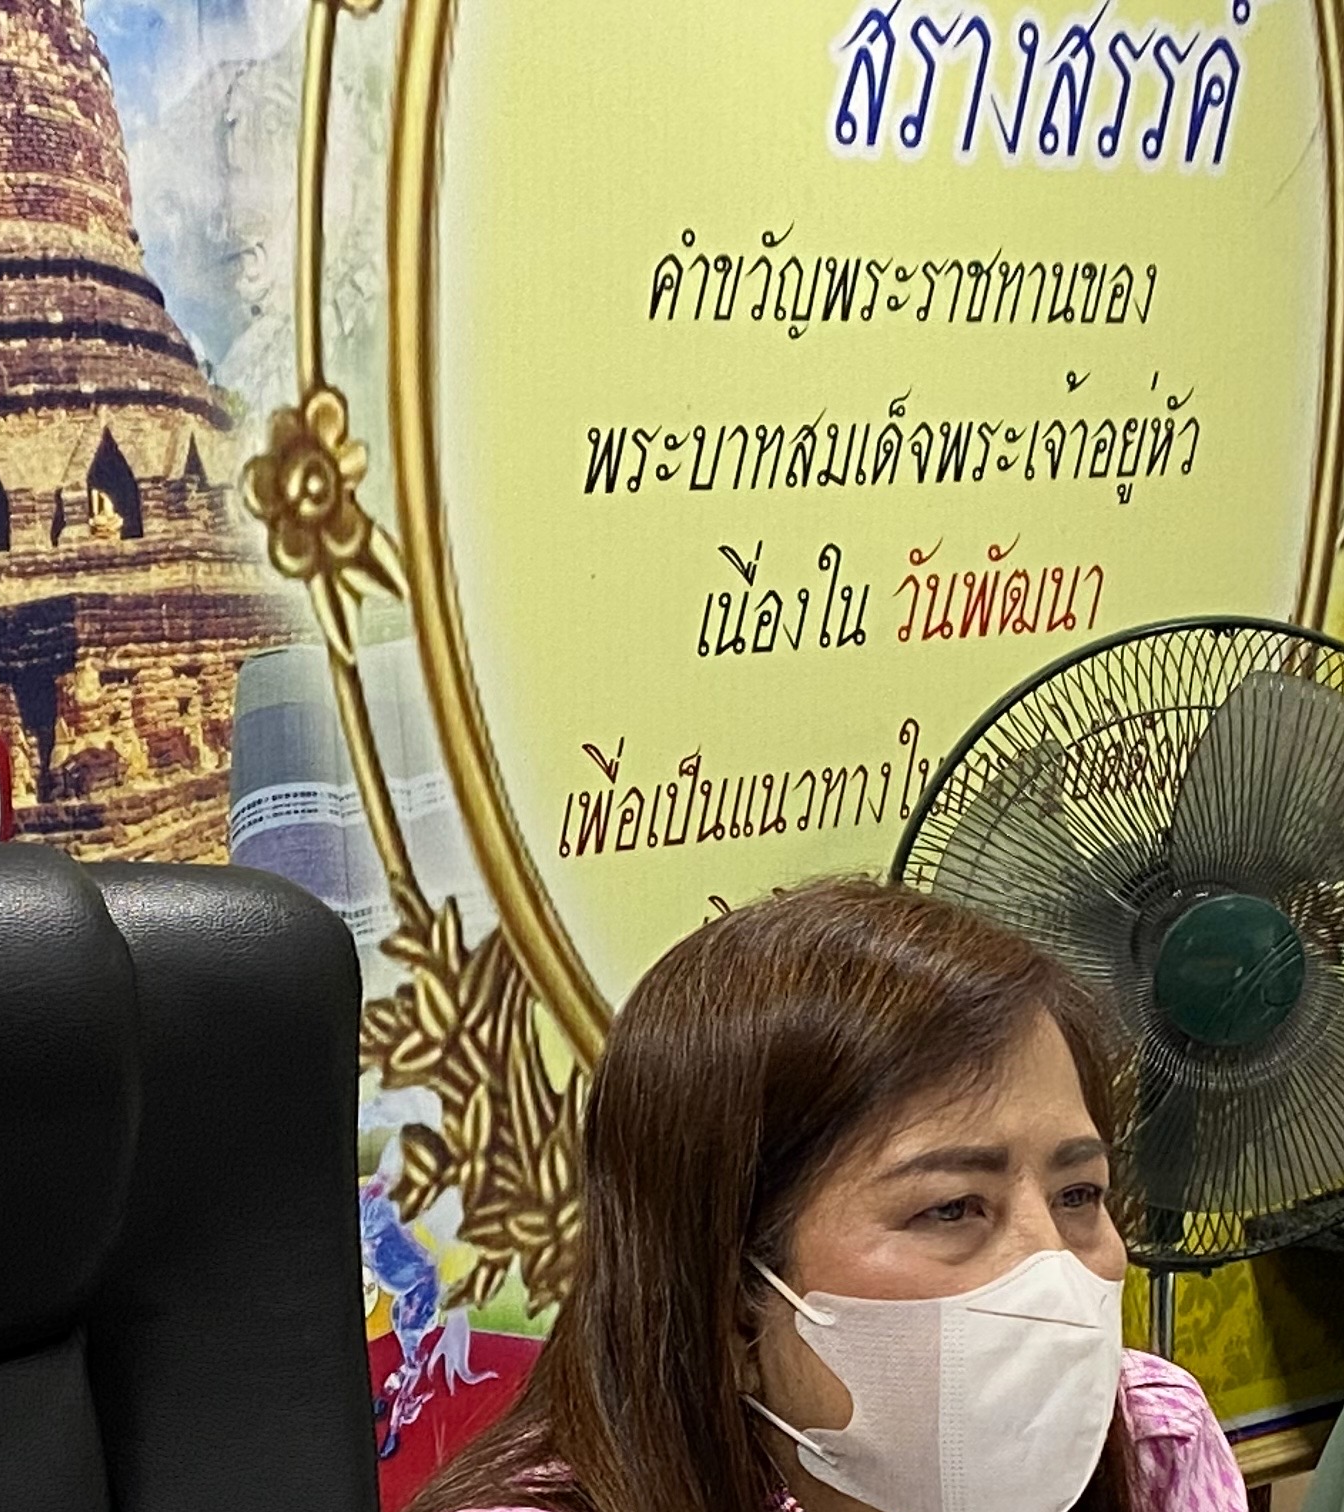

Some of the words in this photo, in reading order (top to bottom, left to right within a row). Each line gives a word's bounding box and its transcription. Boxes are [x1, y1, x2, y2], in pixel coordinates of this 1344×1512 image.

[649, 220, 1157, 340] คำขวัญพระราชทานของ
[584, 370, 1201, 504] พระบาทสมเด็จพระเจ้าอยู่หัว
[696, 541, 870, 657] เนื่องใน
[894, 533, 1105, 646] วันพัฒนา
